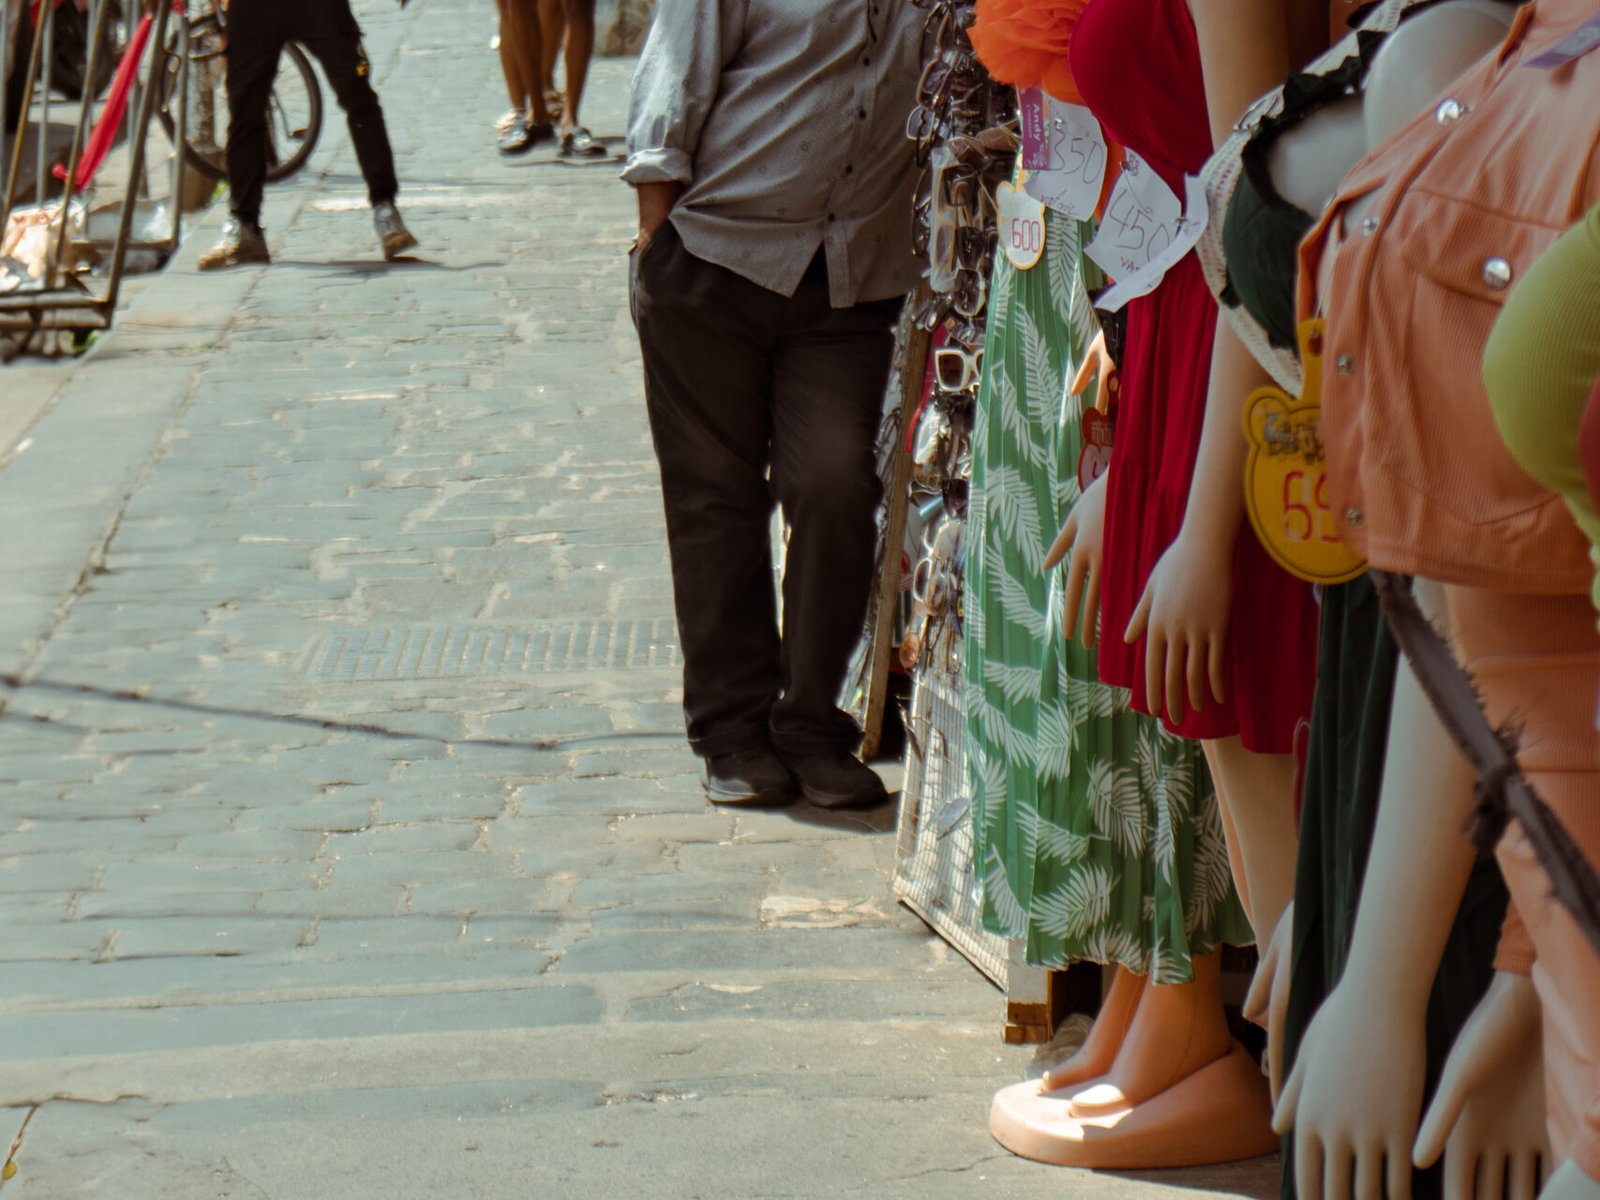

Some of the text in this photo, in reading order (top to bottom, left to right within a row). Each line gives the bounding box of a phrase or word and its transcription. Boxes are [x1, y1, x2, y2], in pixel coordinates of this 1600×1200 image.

[1033, 104, 1043, 141] Andy
[1048, 128, 1104, 184] 350
[1012, 218, 1040, 253] 600
[1110, 189, 1170, 262] 450
